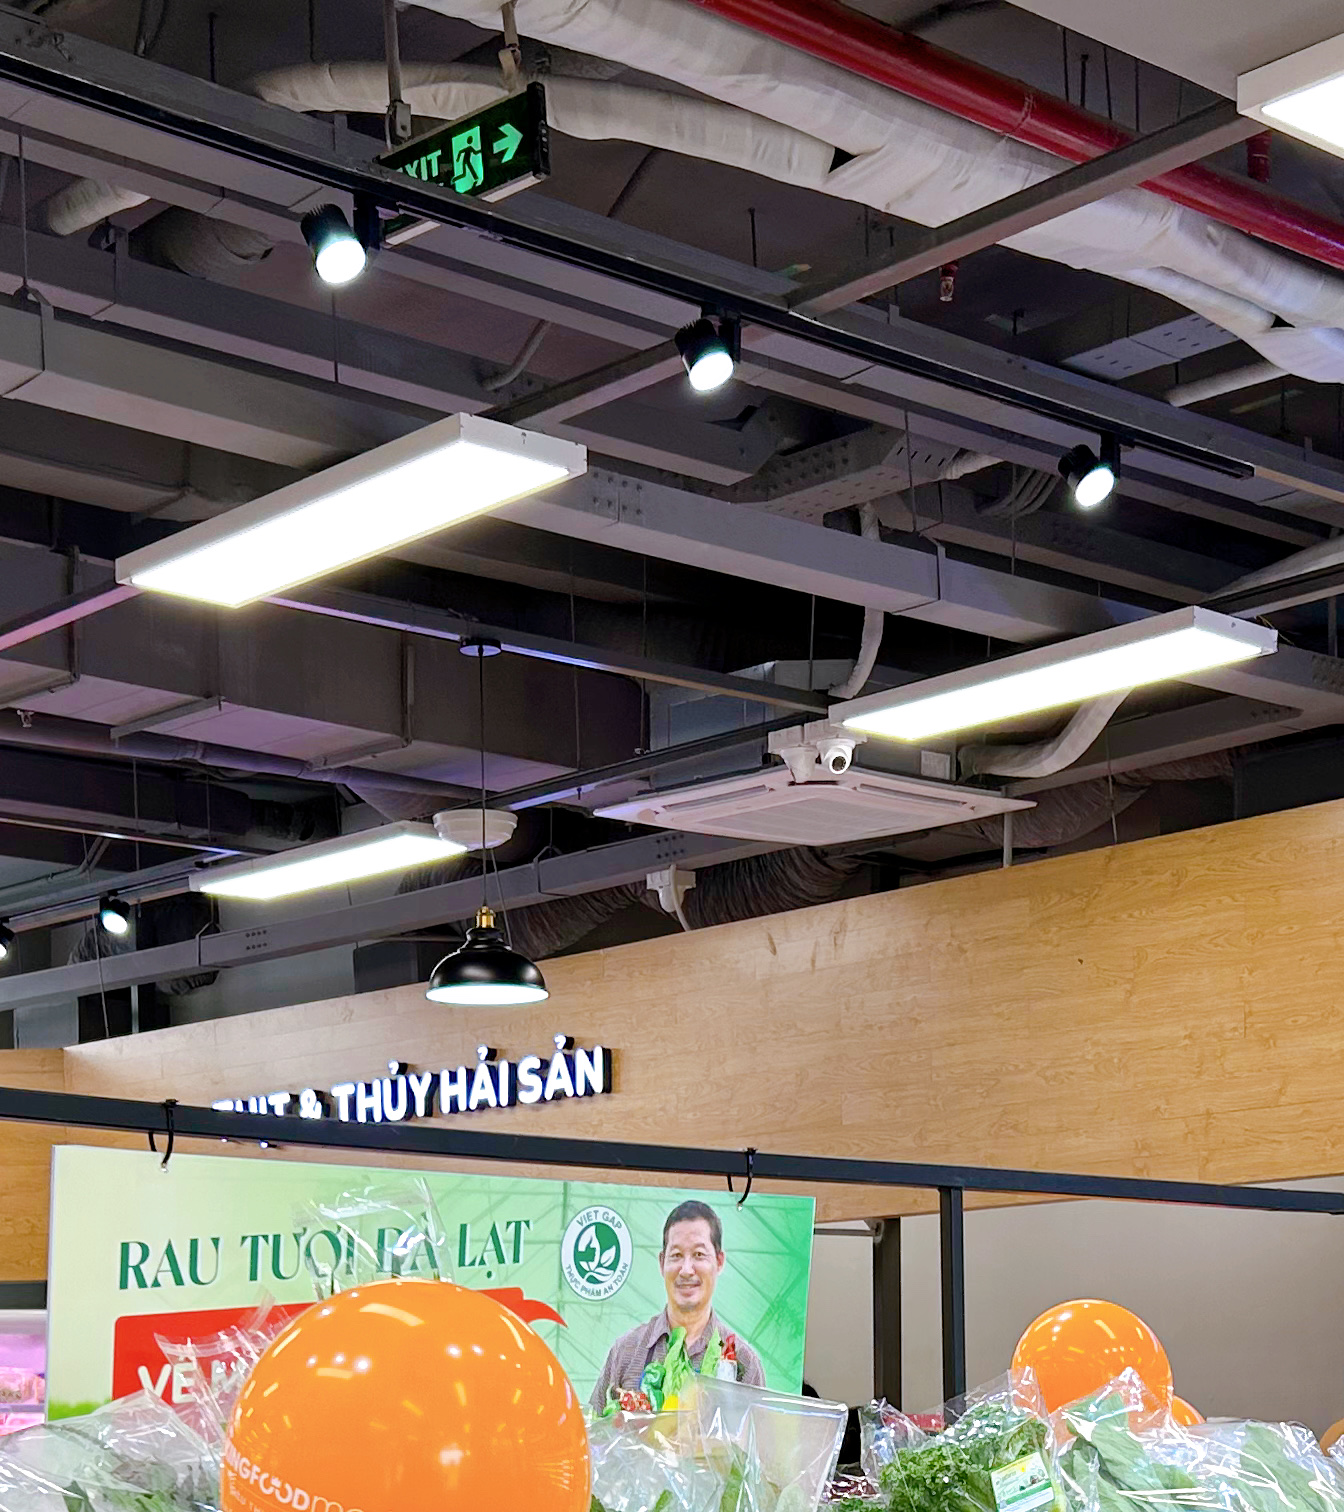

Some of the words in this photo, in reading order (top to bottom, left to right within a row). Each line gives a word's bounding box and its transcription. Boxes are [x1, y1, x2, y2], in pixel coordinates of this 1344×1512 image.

[396, 150, 442, 182] XIT
[331, 1059, 434, 1123] THỦY
[439, 1045, 510, 1114] HẢI
[517, 1033, 605, 1104] SẢN
[576, 1210, 599, 1227] VIET
[602, 1212, 623, 1229] GAP
[118, 1235, 222, 1291] RAU
[458, 1219, 533, 1280] LẠT
